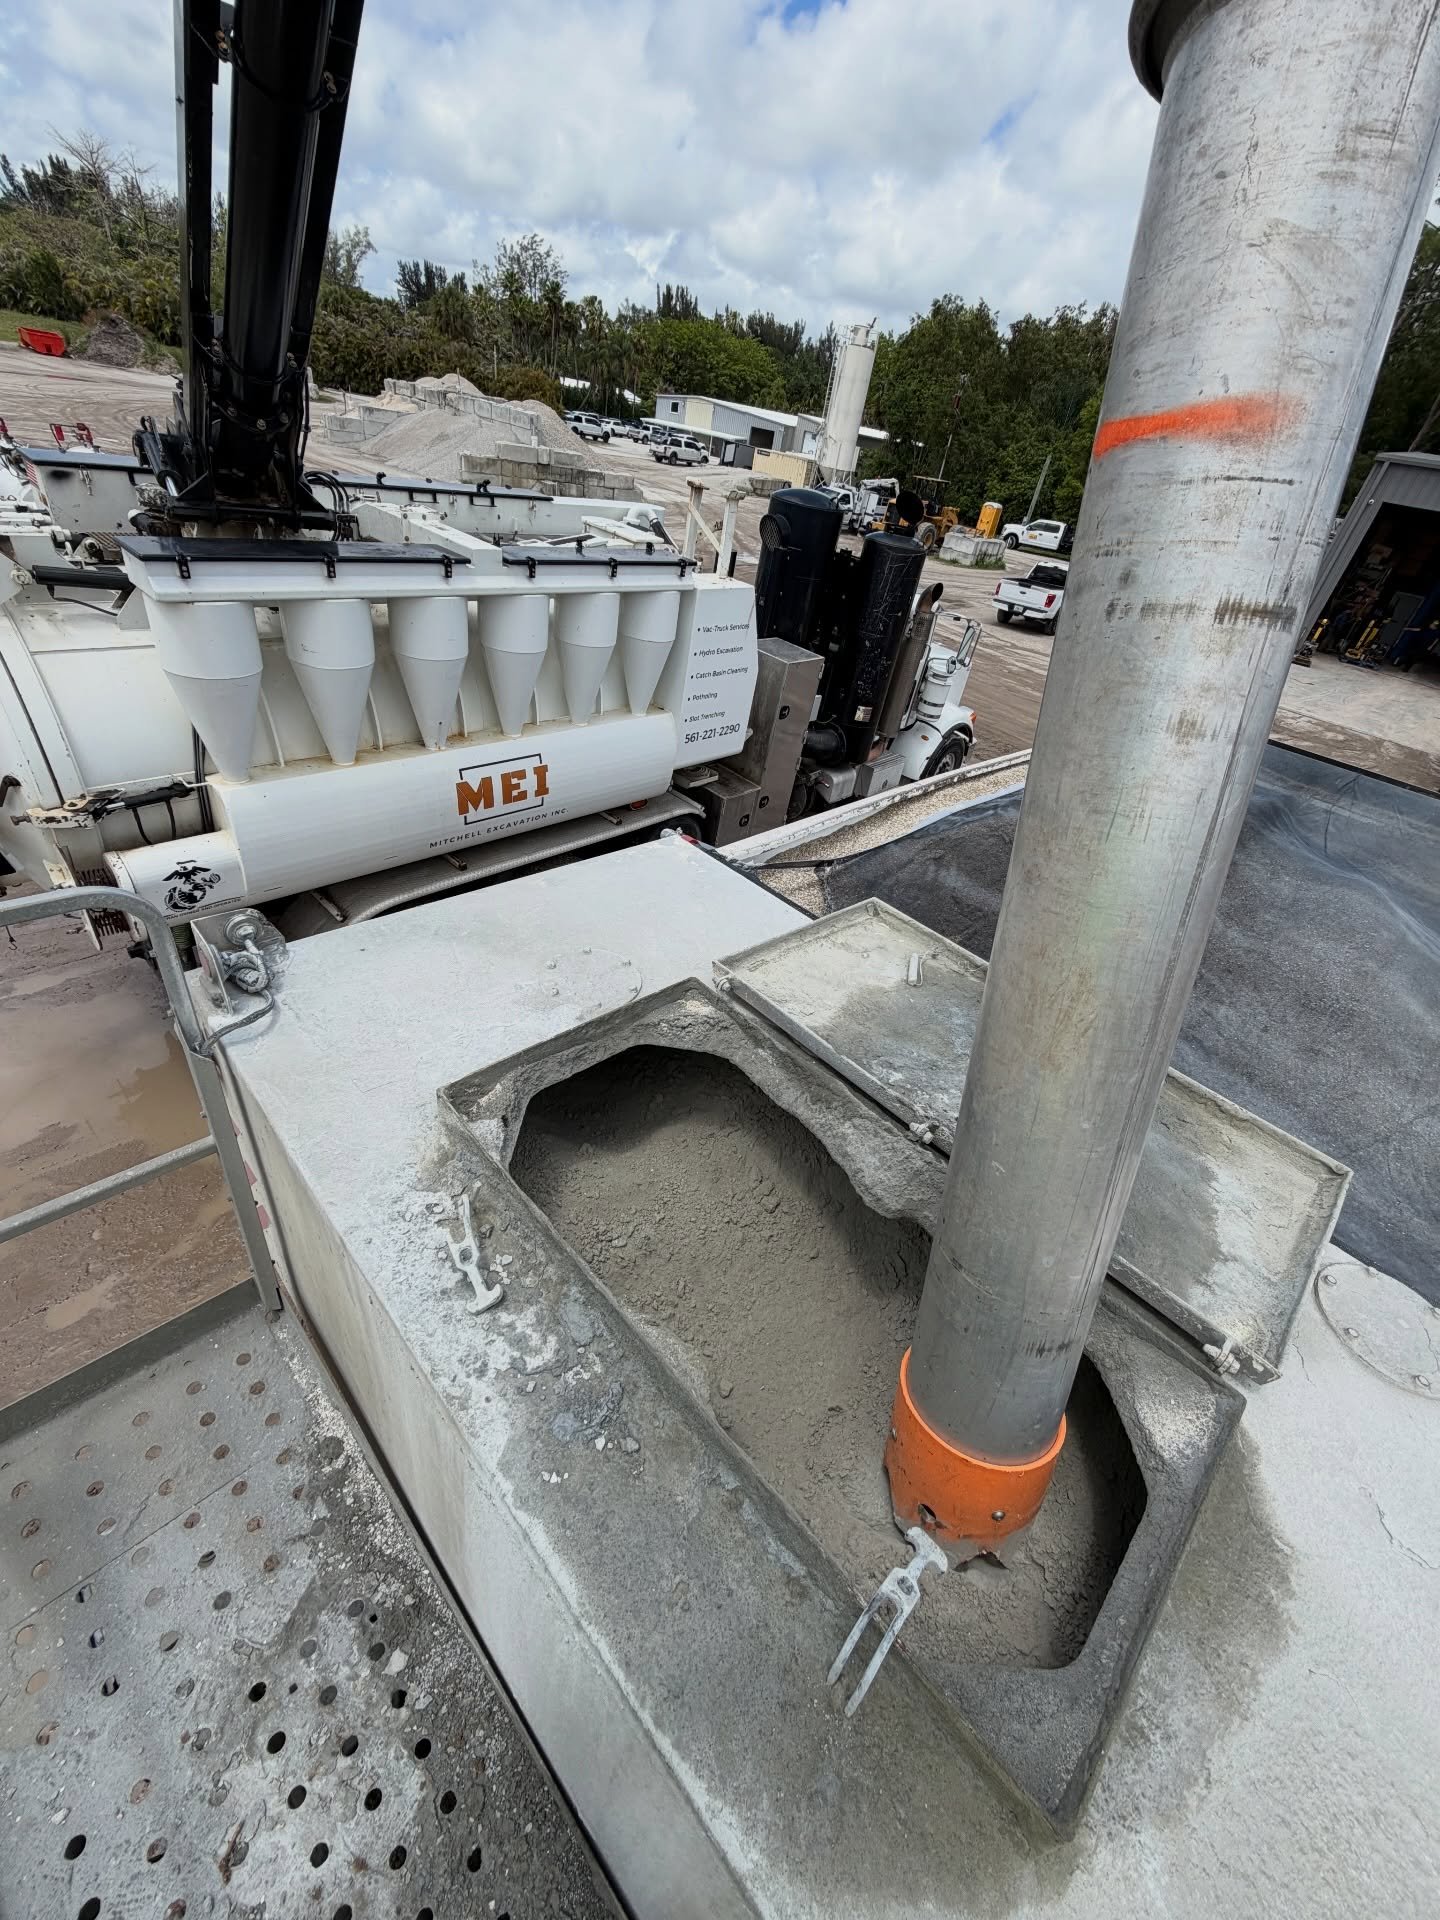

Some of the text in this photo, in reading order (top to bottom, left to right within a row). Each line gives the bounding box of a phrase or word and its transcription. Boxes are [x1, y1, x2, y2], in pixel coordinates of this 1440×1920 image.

[684, 723, 740, 744] 561-221-2290
[456, 764, 549, 816] MEI
[429, 808, 569, 848] MITCHELL EXCAVATION INC.
